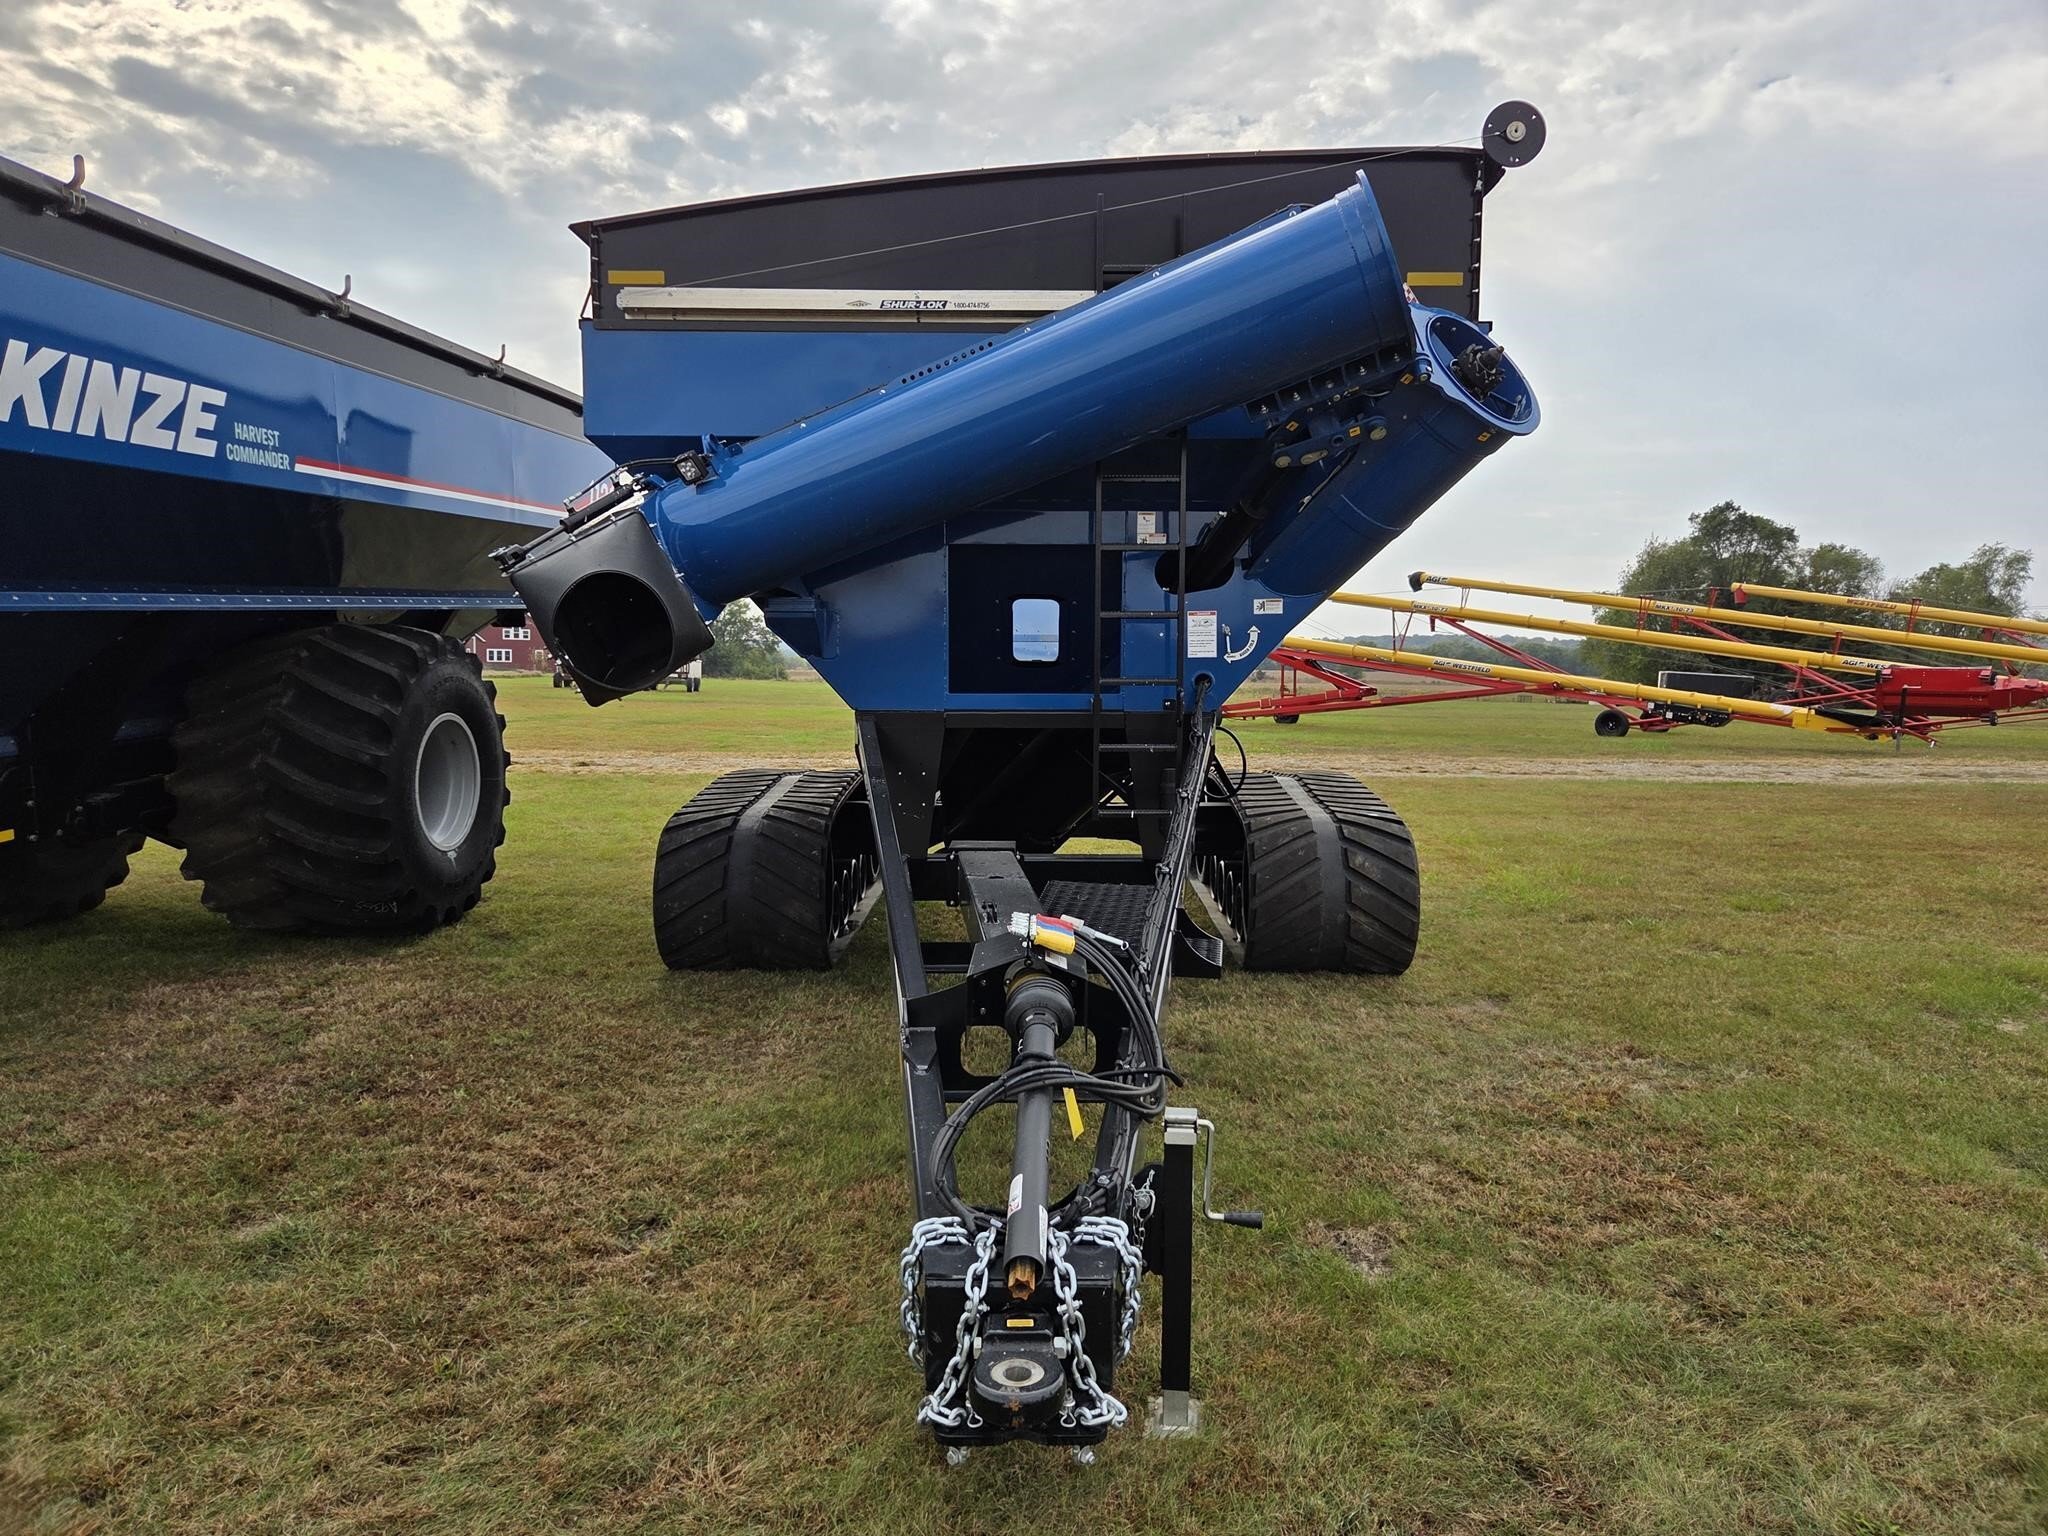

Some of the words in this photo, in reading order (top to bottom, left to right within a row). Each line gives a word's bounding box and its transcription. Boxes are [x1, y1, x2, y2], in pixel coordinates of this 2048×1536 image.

[0, 339, 228, 458] KINZE
[234, 422, 280, 447] HARVEST
[226, 443, 290, 470] COMMANDER
[1425, 575, 1441, 583] AGI
[1846, 598, 1897, 609] WESTFIELD
[1452, 663, 1491, 673] WESTFIELD
